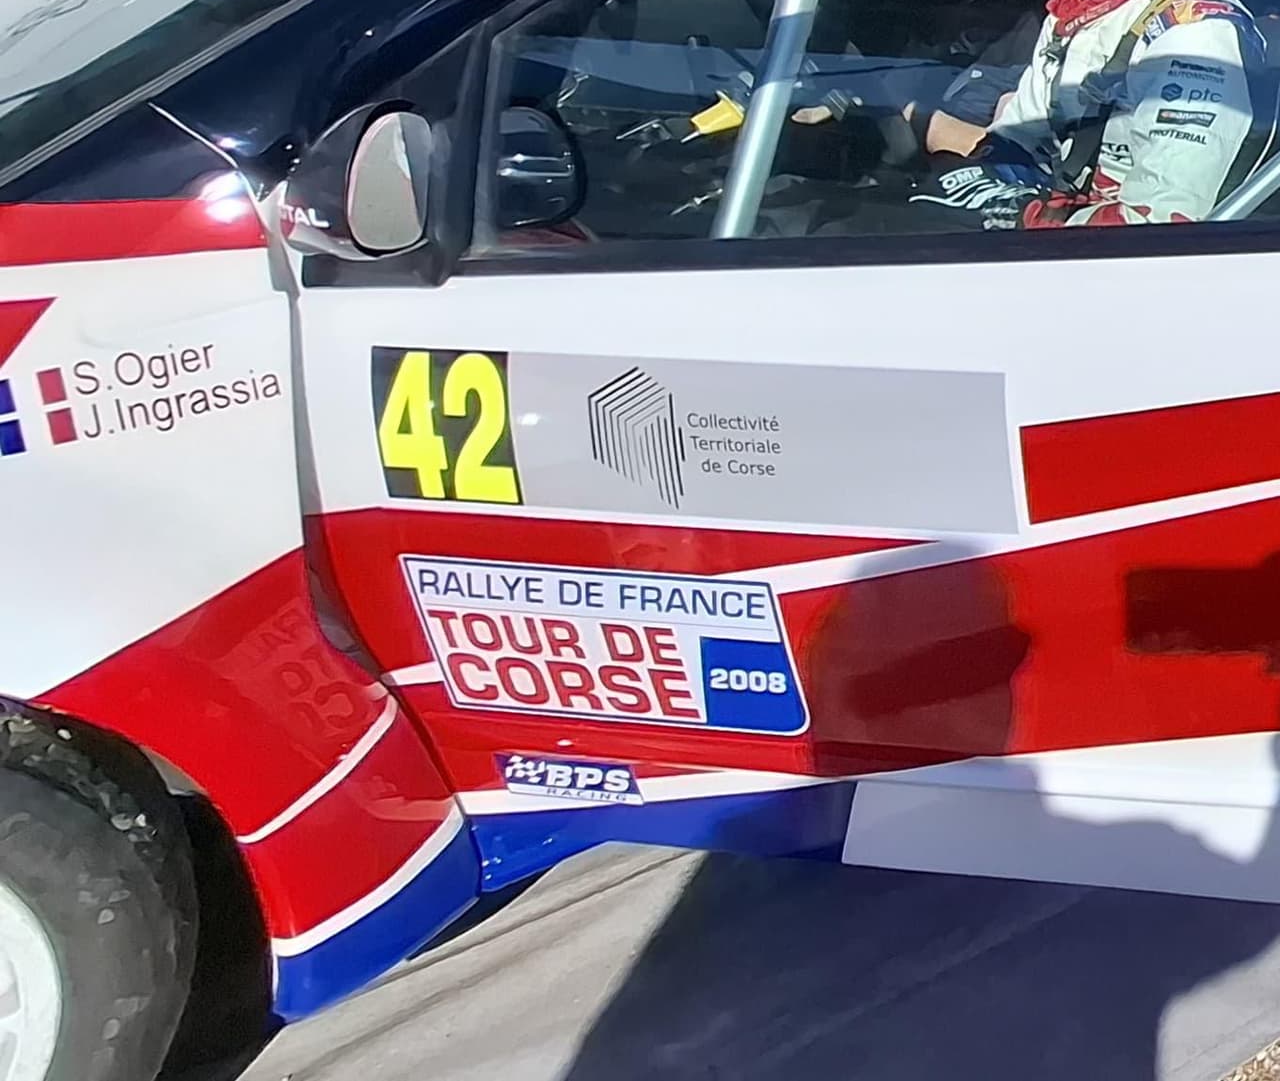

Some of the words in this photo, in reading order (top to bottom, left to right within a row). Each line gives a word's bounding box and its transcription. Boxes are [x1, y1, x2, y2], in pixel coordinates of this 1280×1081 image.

[1188, 88, 1223, 103] ptc
[73, 343, 213, 395] S.Ogier
[84, 369, 281, 439] J.Ingrassia
[687, 413, 780, 432] Collectivité
[379, 351, 519, 503] 42
[690, 435, 781, 455] Territoriale
[701, 458, 722, 474] de
[726, 459, 775, 476] Corse
[418, 569, 543, 603] RALLYE
[558, 579, 604, 609] DE
[619, 584, 766, 620] FRANCE
[427, 610, 587, 660] TOUR
[599, 622, 684, 667] DE
[446, 652, 701, 719] CORSE
[709, 668, 787, 694] 2008
[546, 764, 632, 793] BPS
